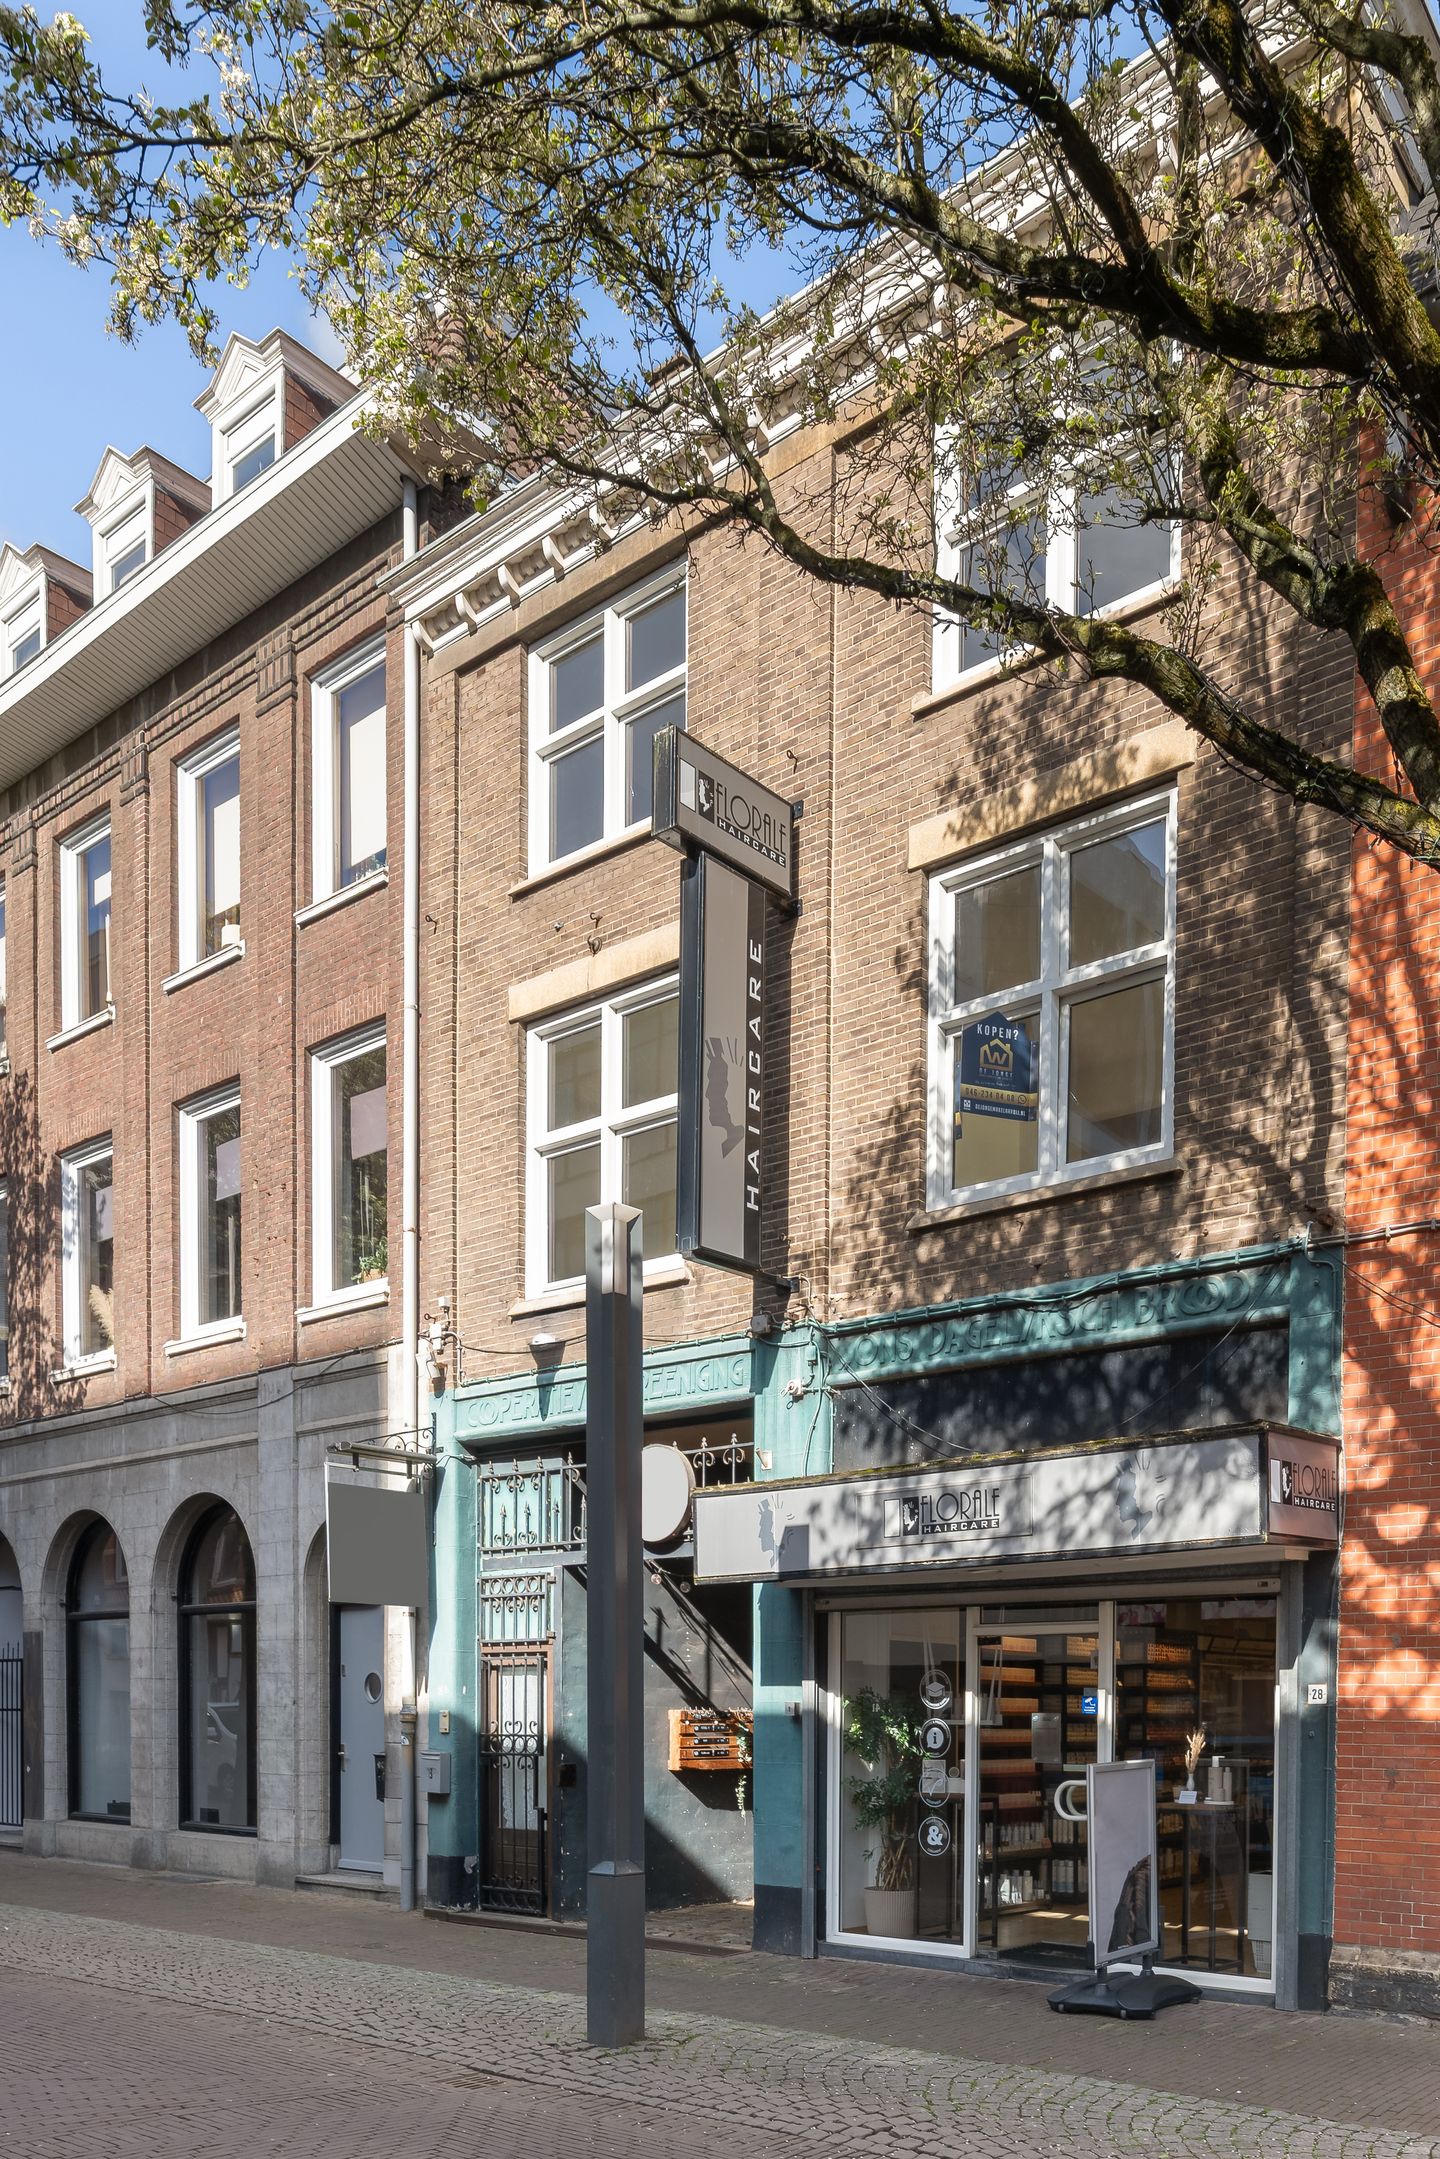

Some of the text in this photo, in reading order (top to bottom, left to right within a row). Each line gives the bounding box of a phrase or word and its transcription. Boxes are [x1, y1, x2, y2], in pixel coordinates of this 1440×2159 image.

[715, 778, 787, 856] FLORALE
[718, 819, 786, 866] HAIRCARE
[977, 1024, 1019, 1041] KOPEN?
[746, 939, 763, 1211] HAIRCARE
[1135, 1270, 1250, 1326] BROOD
[1293, 1463, 1336, 1500] FLORALE
[920, 1488, 1000, 1523] FLORALE
[1294, 1497, 1336, 1511] HAIRCARE
[923, 1520, 998, 1533] HAIRCARE
[1311, 1688, 1324, 1700] 28
